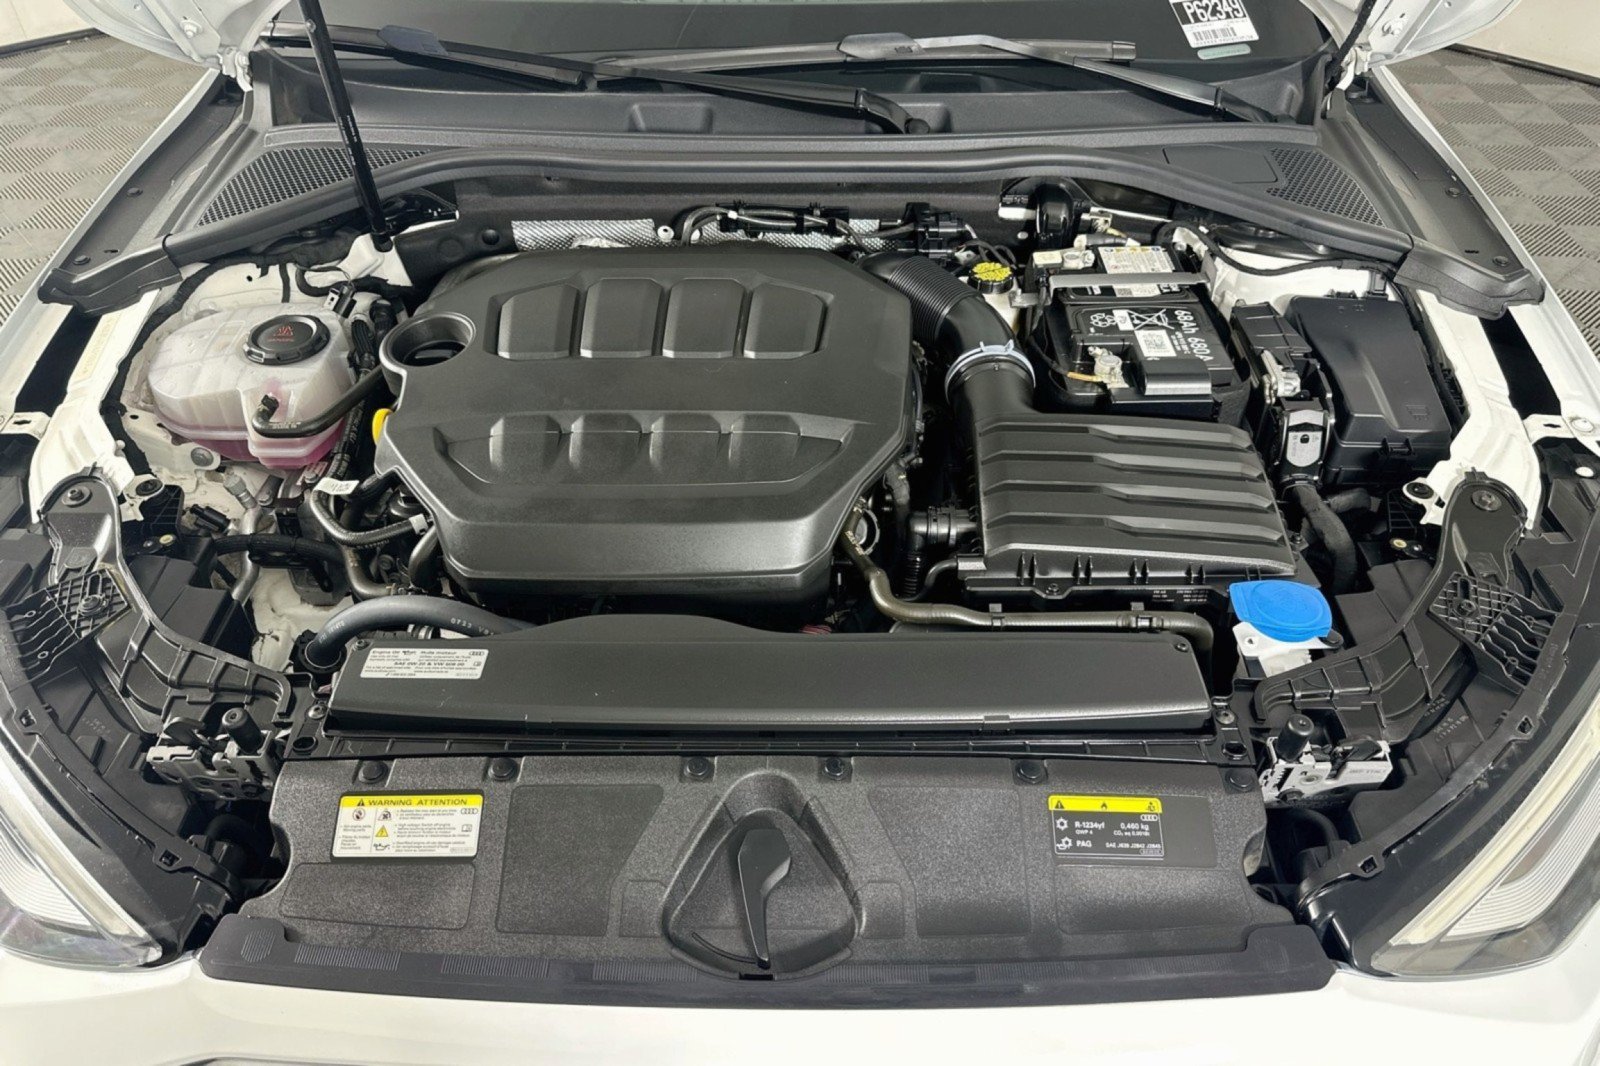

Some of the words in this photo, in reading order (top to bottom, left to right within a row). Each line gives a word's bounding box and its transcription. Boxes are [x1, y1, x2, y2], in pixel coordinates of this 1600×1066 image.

[1182, 0, 1244, 23] P62349
[1174, 310, 1199, 334] 68Ah
[1188, 338, 1214, 361] 680A
[1074, 821, 1106, 830] R-1234yf
[1120, 822, 1140, 830] 0,460
[1140, 822, 1149, 831] kg
